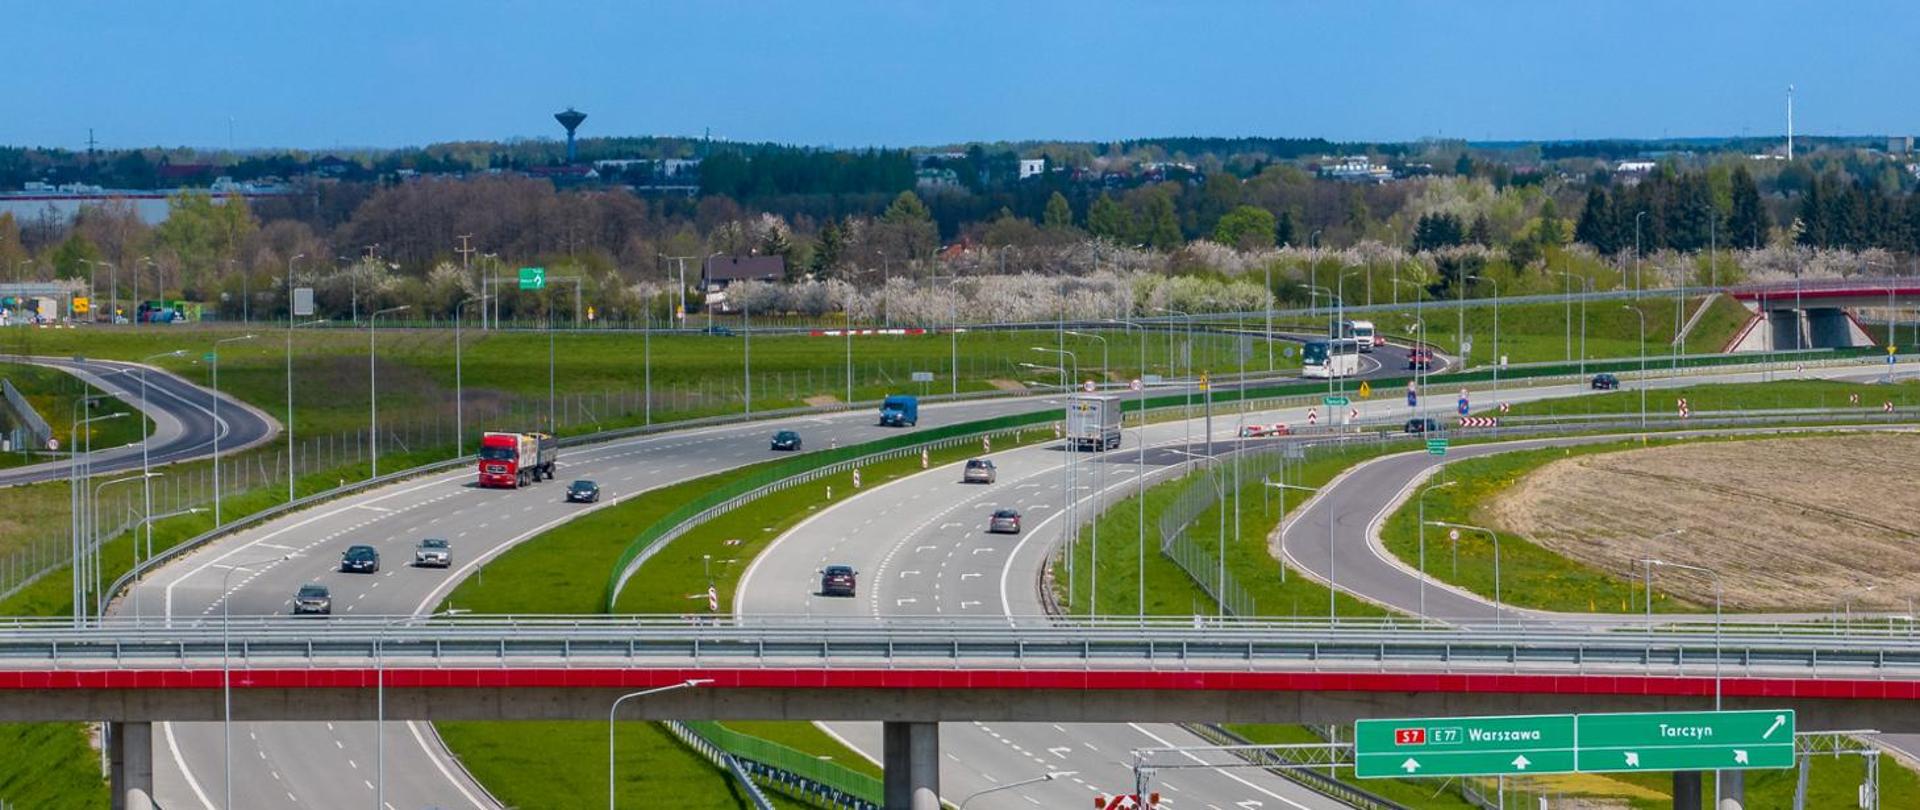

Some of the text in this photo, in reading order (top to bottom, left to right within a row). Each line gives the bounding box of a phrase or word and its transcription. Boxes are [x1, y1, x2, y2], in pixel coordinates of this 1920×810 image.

[1435, 730, 1442, 741] E
[1444, 730, 1456, 741] 77
[1468, 728, 1541, 741] Warszawa
[1659, 724, 1713, 740] Tarczyn
